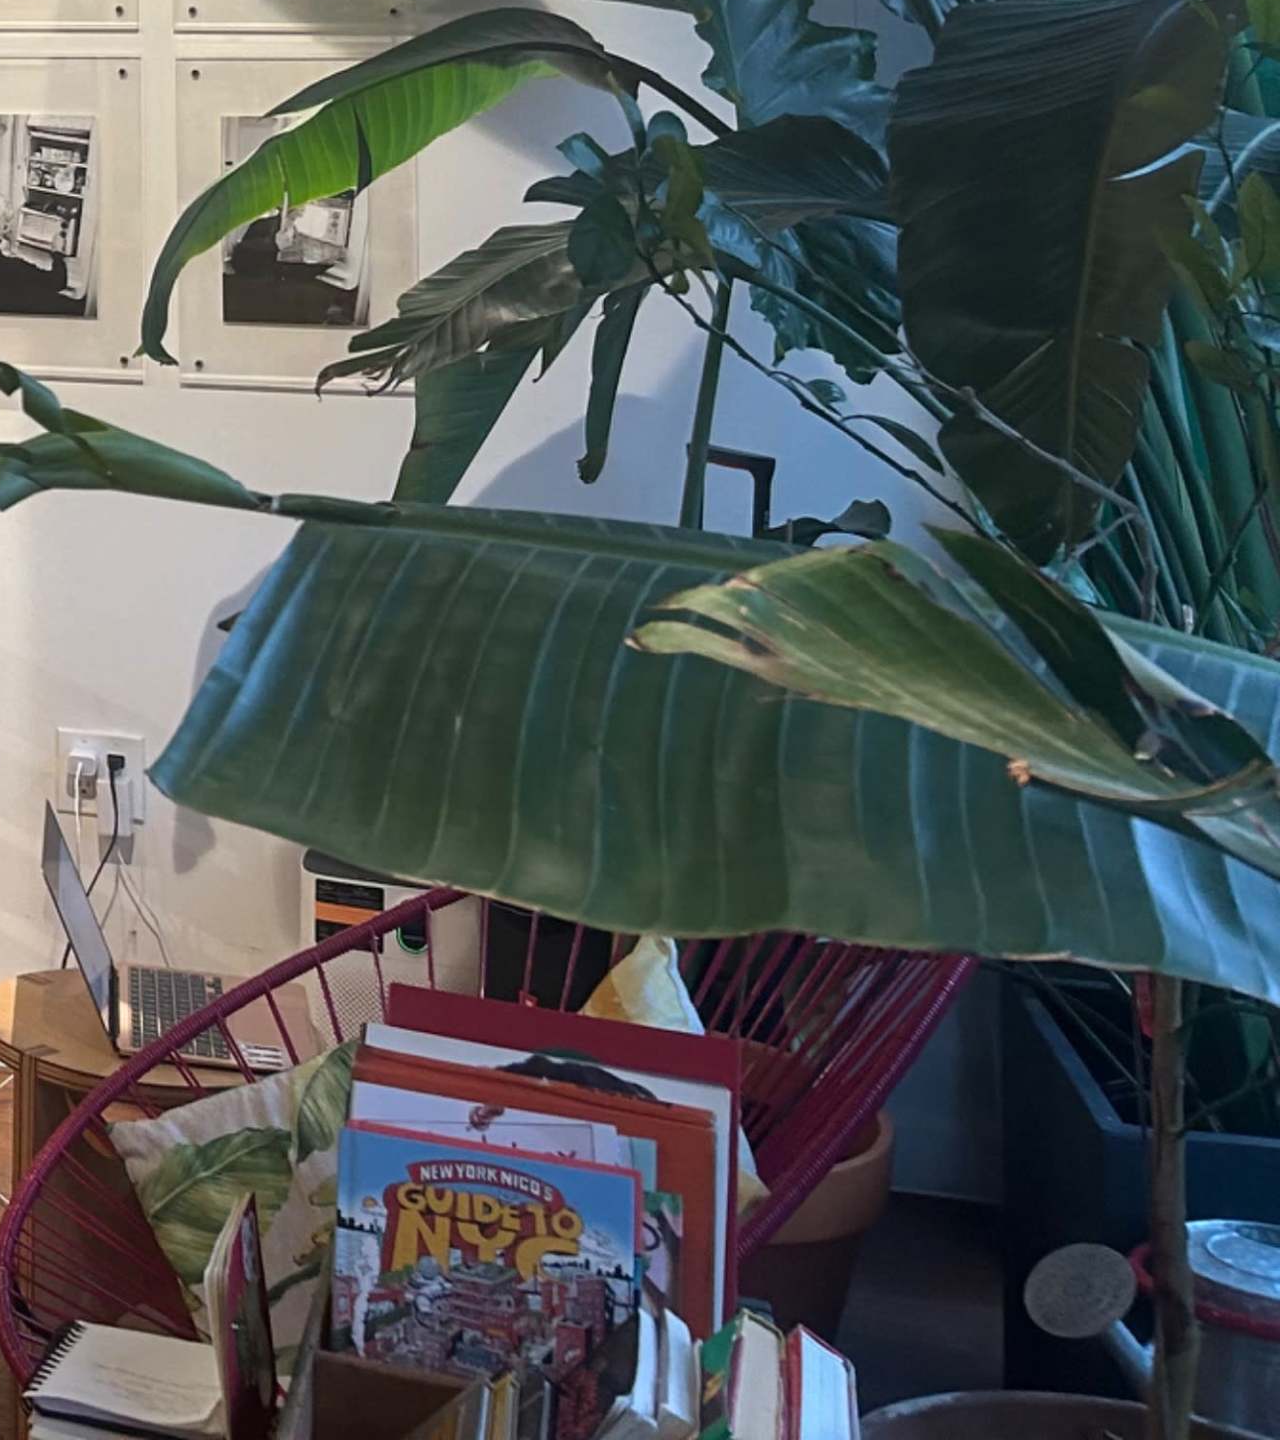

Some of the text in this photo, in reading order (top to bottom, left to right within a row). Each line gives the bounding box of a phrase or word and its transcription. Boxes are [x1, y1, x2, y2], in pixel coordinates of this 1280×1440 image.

[420, 1164, 453, 1182] NEW
[455, 1164, 499, 1184] YORK
[397, 1182, 583, 1240] GUIDE TO
[391, 1209, 580, 1282] NYC
